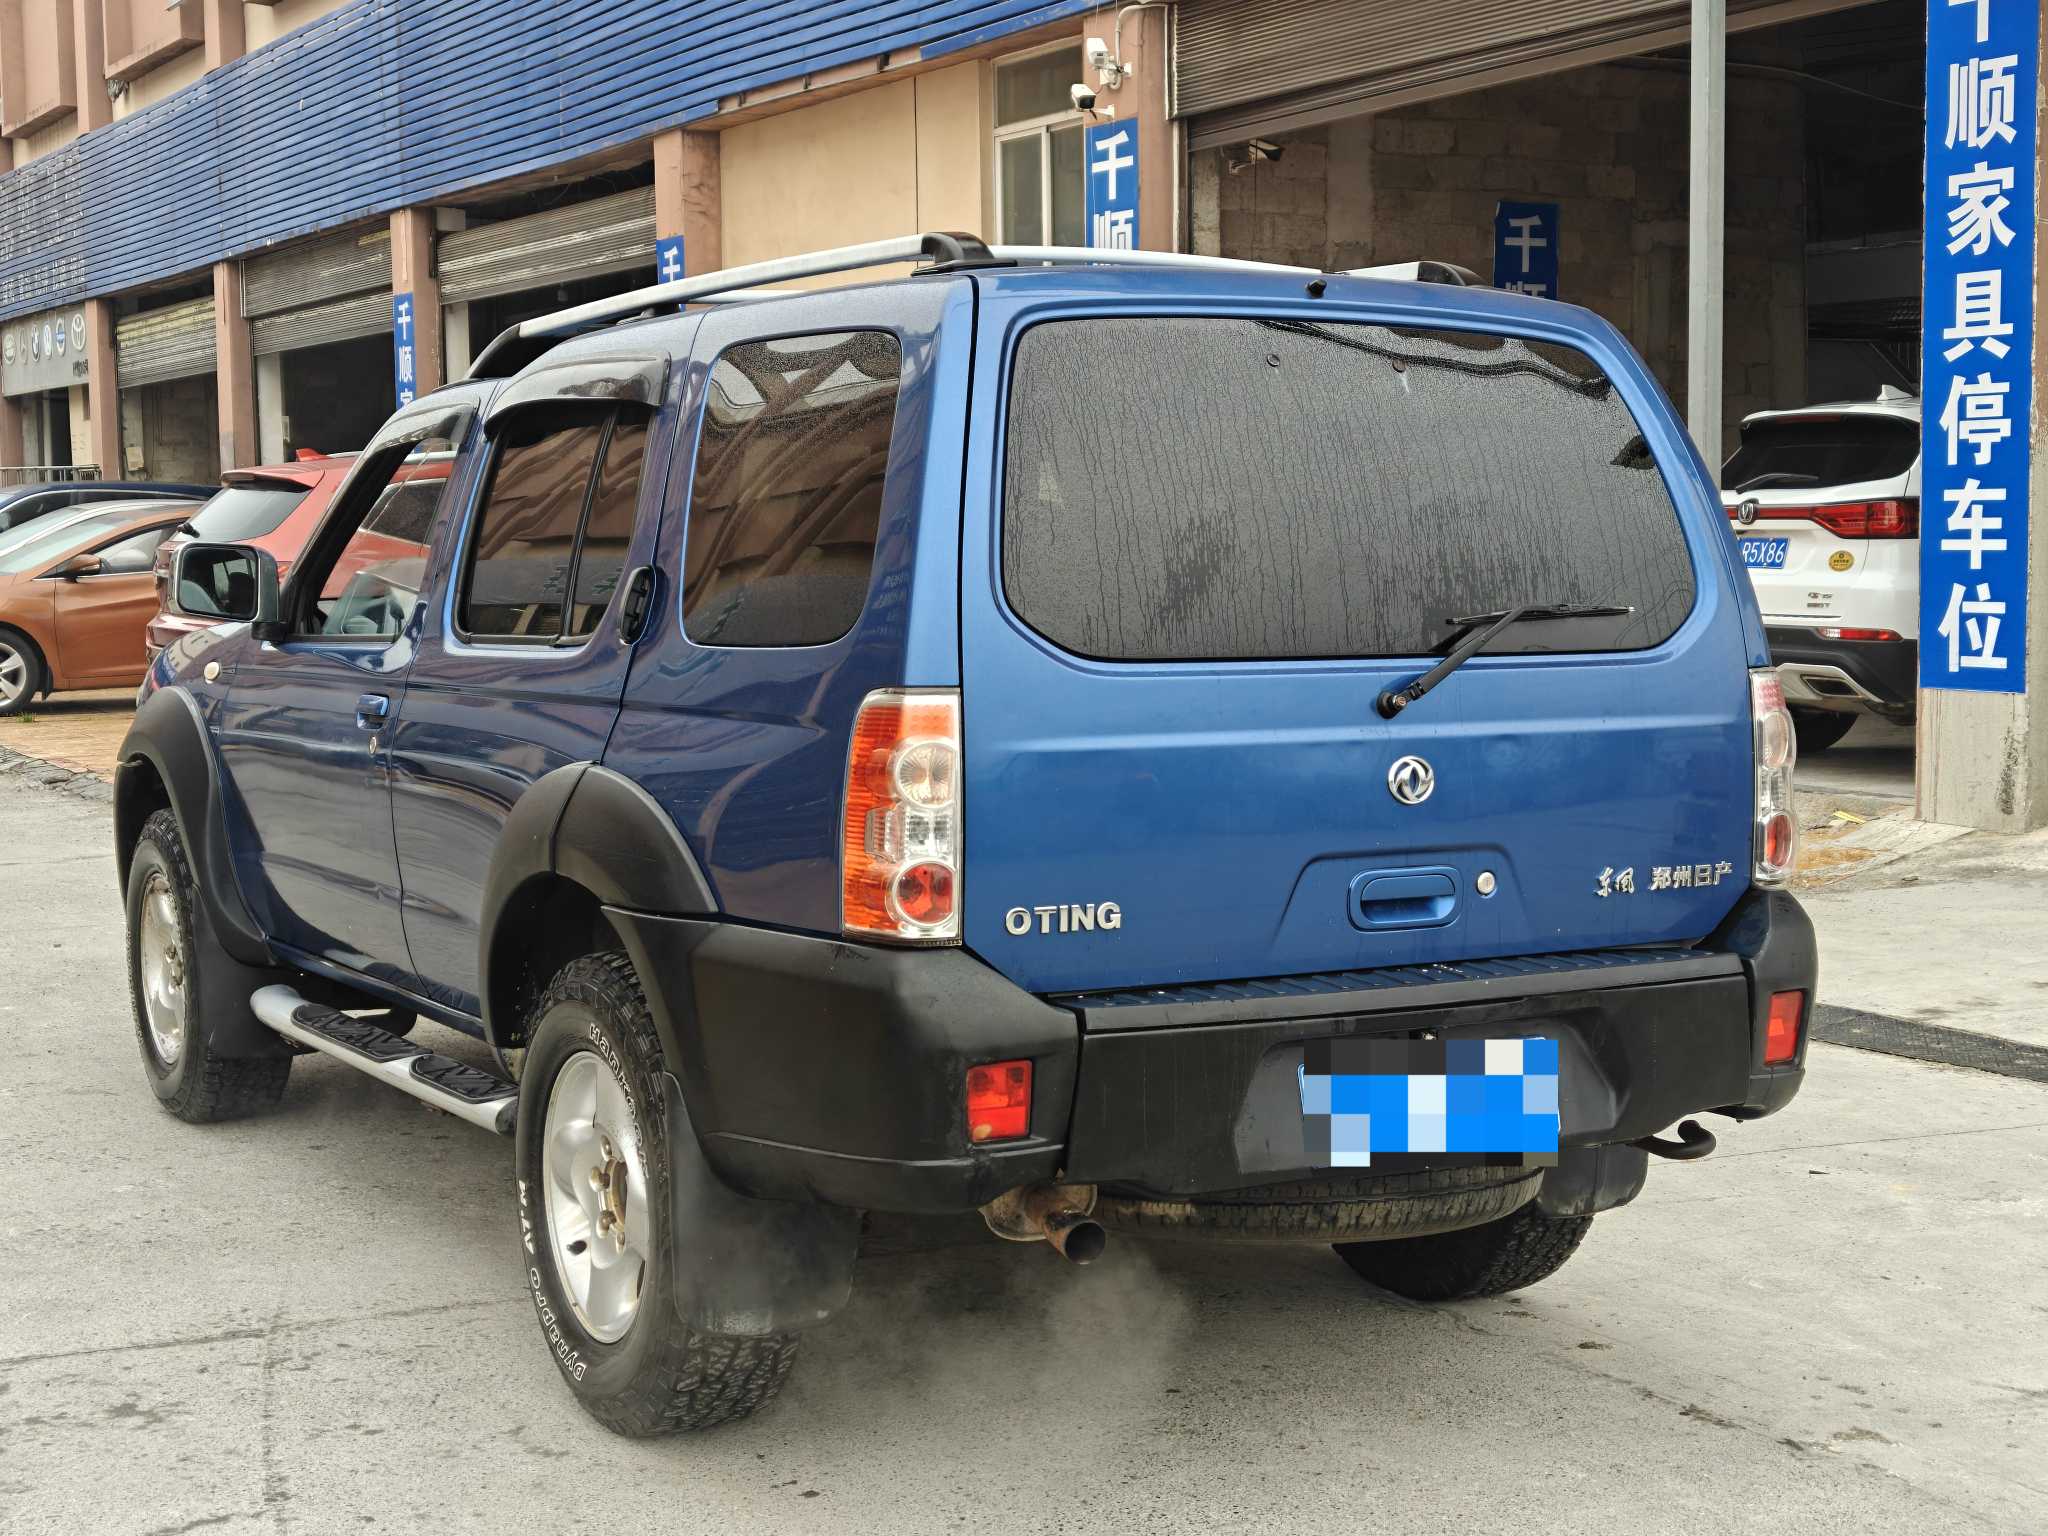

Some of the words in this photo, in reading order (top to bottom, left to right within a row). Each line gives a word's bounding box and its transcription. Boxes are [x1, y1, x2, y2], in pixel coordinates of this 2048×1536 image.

[1092, 130, 1134, 250] 千顺
[663, 245, 681, 282] 千
[1649, 860, 1732, 891] 郑州日产
[1005, 901, 1122, 936] OTING
